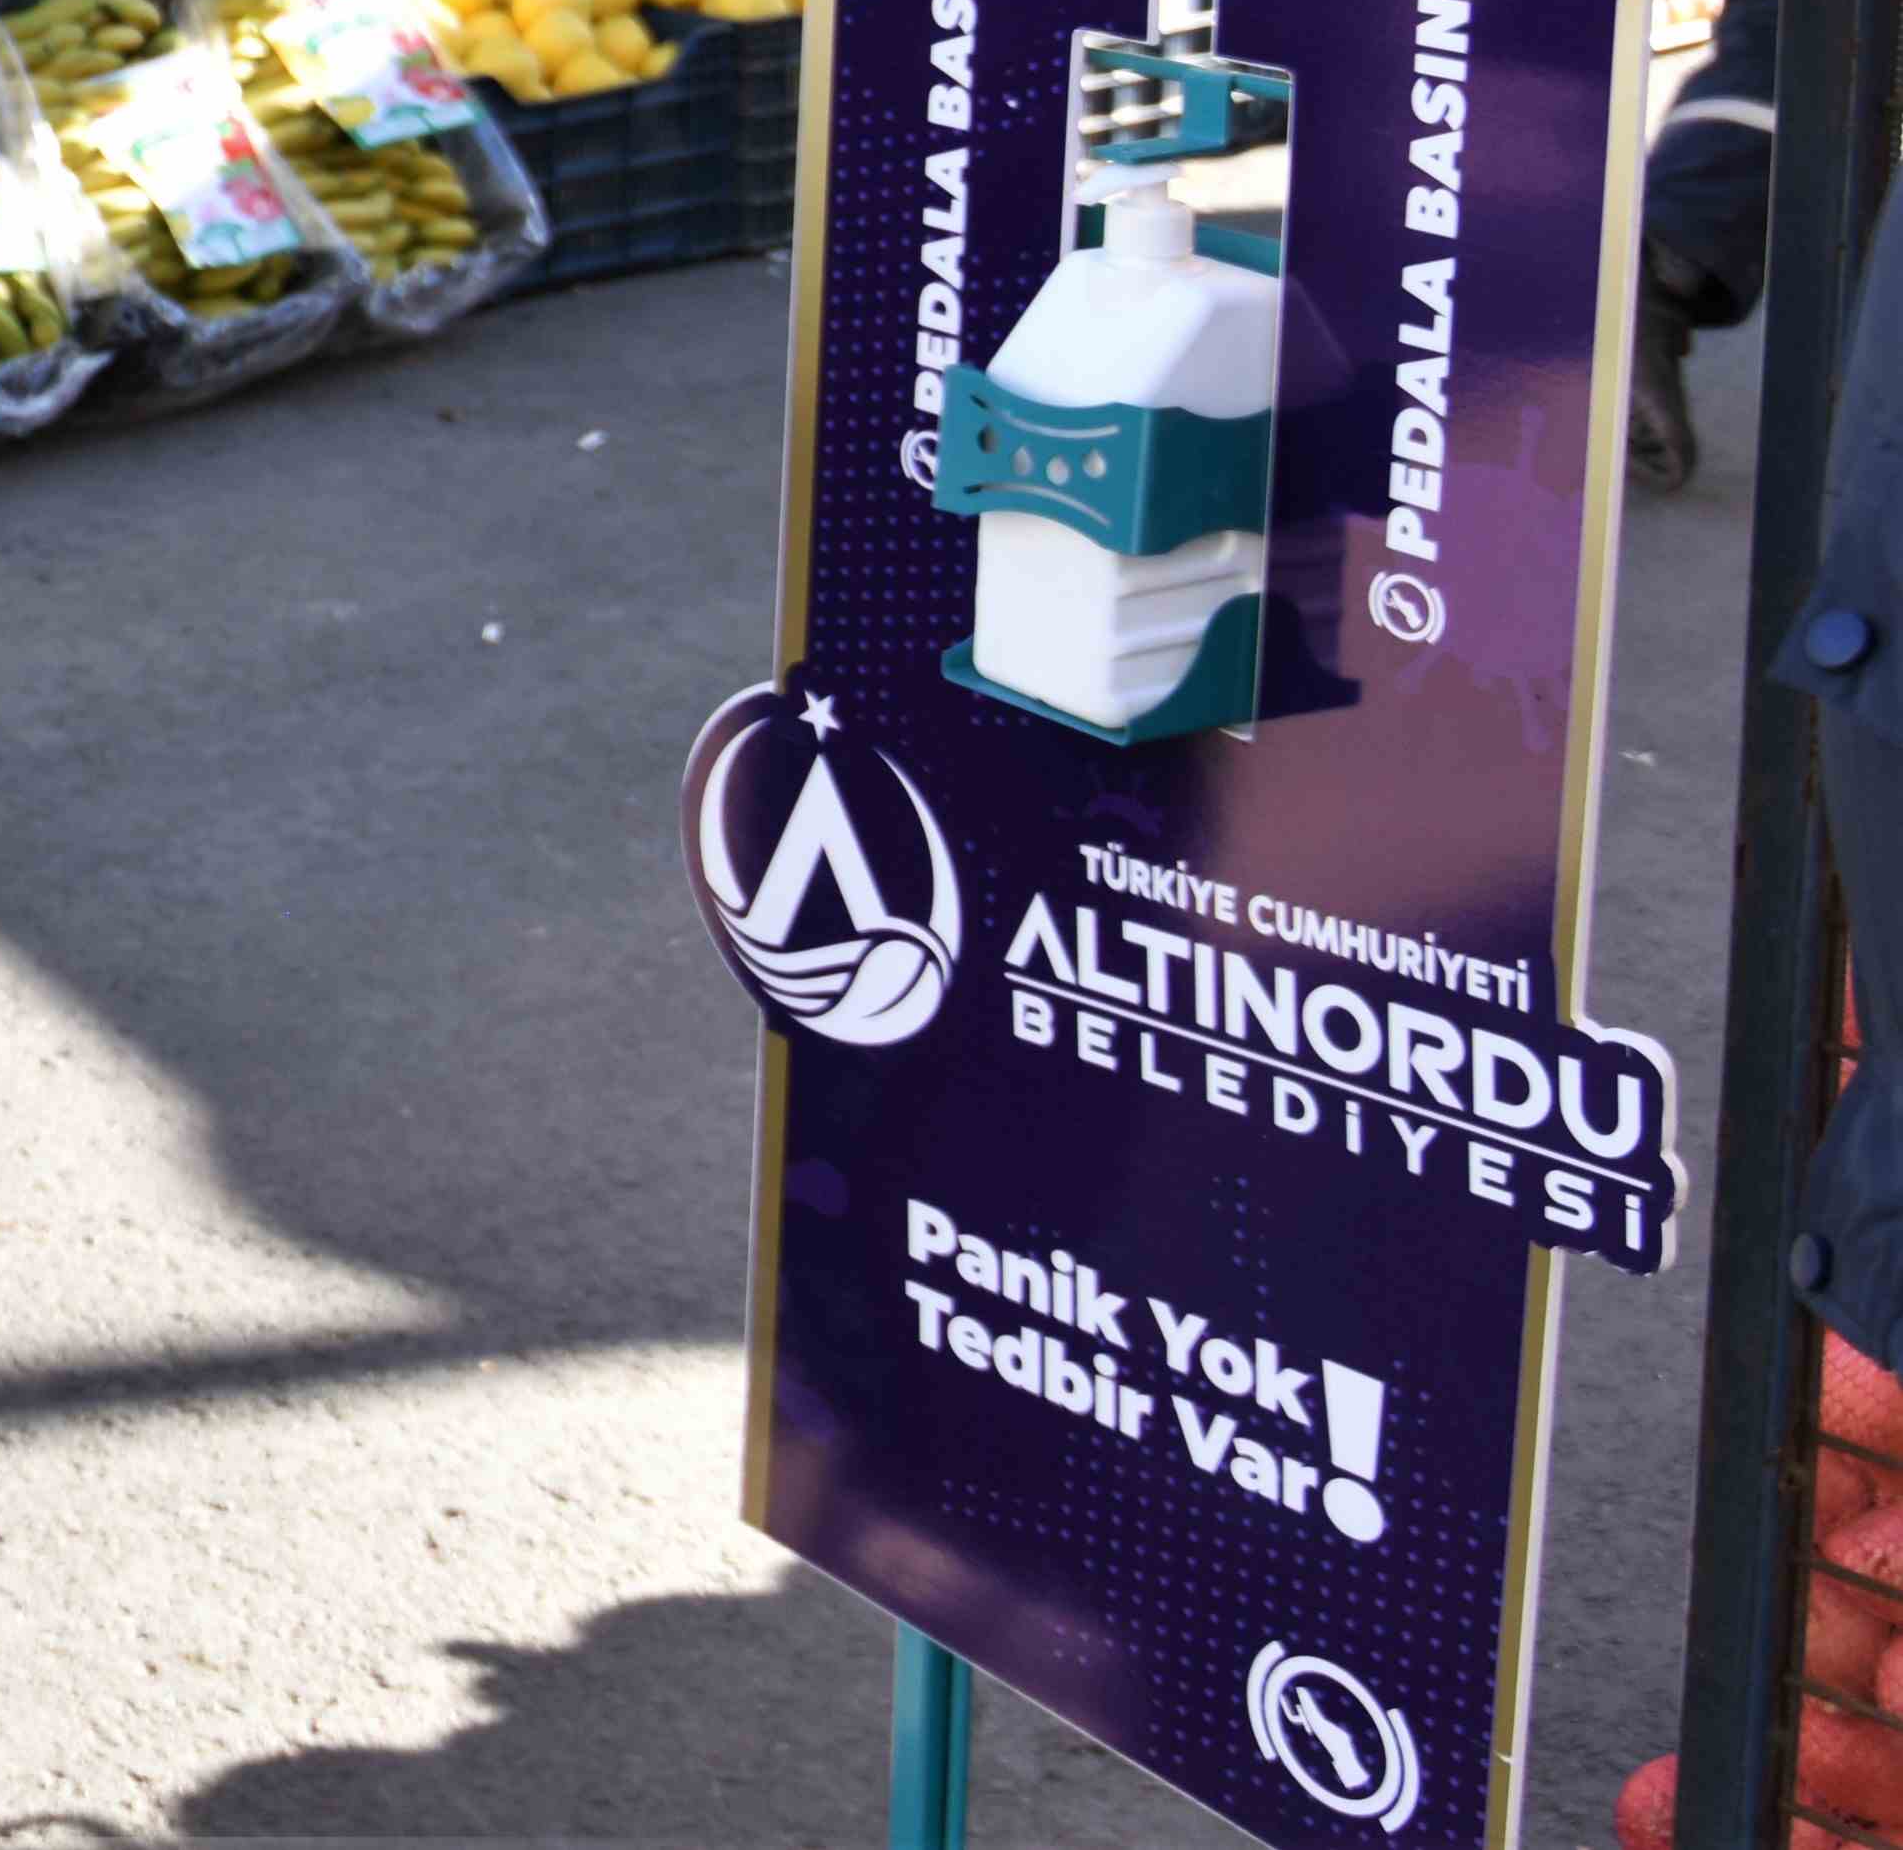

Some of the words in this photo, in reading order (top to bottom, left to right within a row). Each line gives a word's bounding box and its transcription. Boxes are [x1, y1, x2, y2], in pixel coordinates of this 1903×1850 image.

[915, 146, 970, 416] PEDALA
[1385, 256, 1456, 562] PEDALA
[1004, 892, 1643, 1160] ALTINORDU
[1079, 840, 1237, 927] TÜRKİYE
[1247, 891, 1532, 1014] CUMHURİYETİ
[1011, 989, 1645, 1251] BELEDİYESİ
[903, 1277, 1153, 1439] Tedbir
[905, 1197, 1129, 1345] Panik
[1147, 1292, 1311, 1426] Yok
